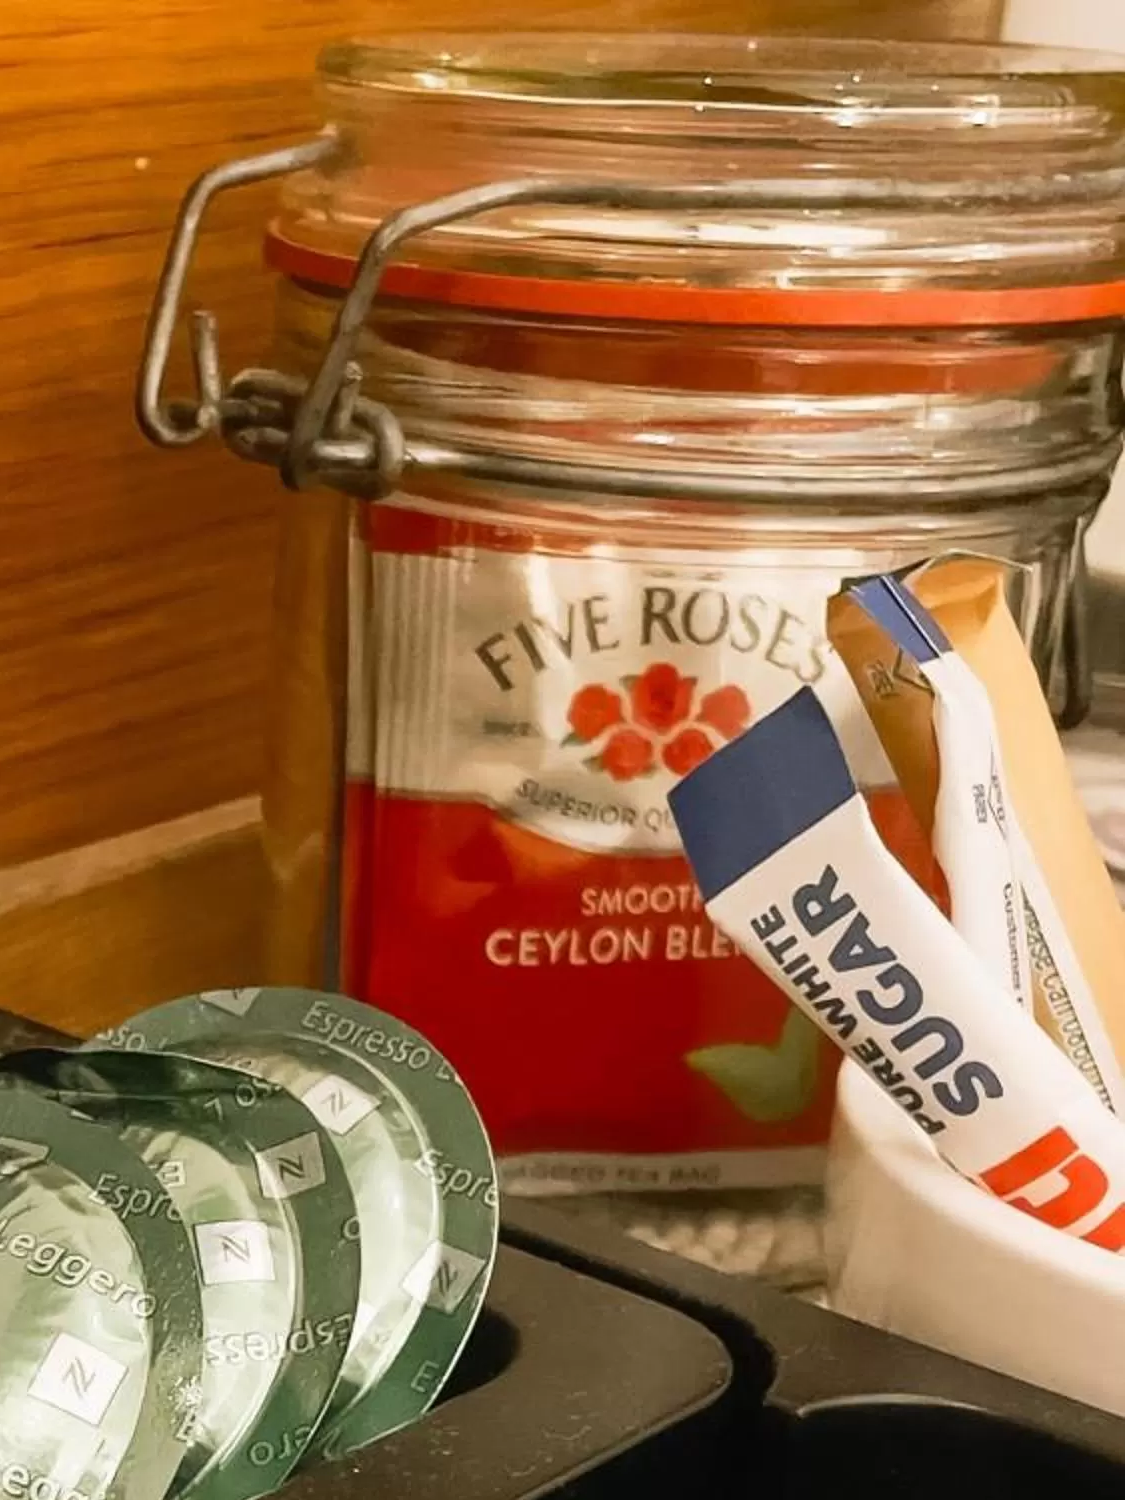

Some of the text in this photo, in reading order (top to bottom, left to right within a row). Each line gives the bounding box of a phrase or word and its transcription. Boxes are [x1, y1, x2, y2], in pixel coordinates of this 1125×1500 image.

[474, 594, 619, 692] FIVE
[639, 587, 832, 684] ROSES
[515, 778, 637, 828] SUPERIOR
[484, 926, 651, 967] CEYLON
[792, 863, 1005, 1117] SUGAR
[302, 1001, 430, 1070] Espresso
[750, 904, 946, 1135] PURE WHITE
